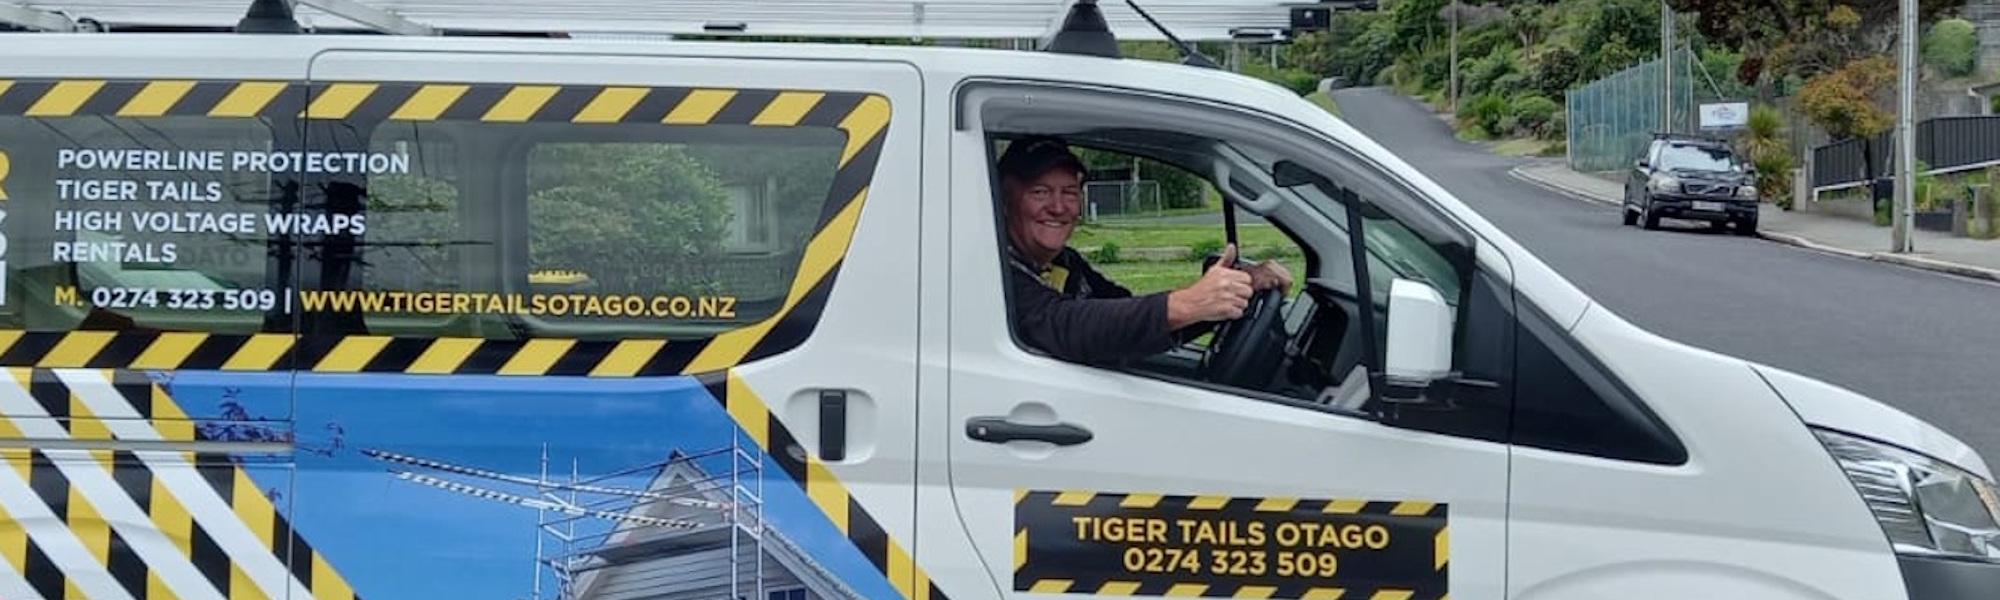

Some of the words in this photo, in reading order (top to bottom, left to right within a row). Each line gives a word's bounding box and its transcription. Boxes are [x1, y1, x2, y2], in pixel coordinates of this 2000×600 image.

[58, 149, 225, 172] POWERLINE
[232, 151, 409, 175] PROTECTION
[56, 179, 138, 201] TIGER
[146, 180, 222, 202] TAILS
[54, 210, 122, 232] HIGH
[131, 210, 256, 234] VOLTAGE
[264, 212, 366, 236] WRAPS
[53, 240, 177, 264] RENTALS
[54, 286, 83, 308] M.
[92, 286, 159, 309] 0274
[167, 287, 216, 310] 323
[223, 289, 275, 312] 509
[300, 290, 736, 318] WWW.TIGERTAILSOTAGO.CO.NZ
[1072, 516, 1168, 543] TIGER
[1177, 519, 1266, 546] TAILS
[1276, 521, 1389, 549] OTAGO
[1124, 547, 1202, 573] 0274
[1211, 550, 1267, 575] 323
[1276, 552, 1338, 577] 509
